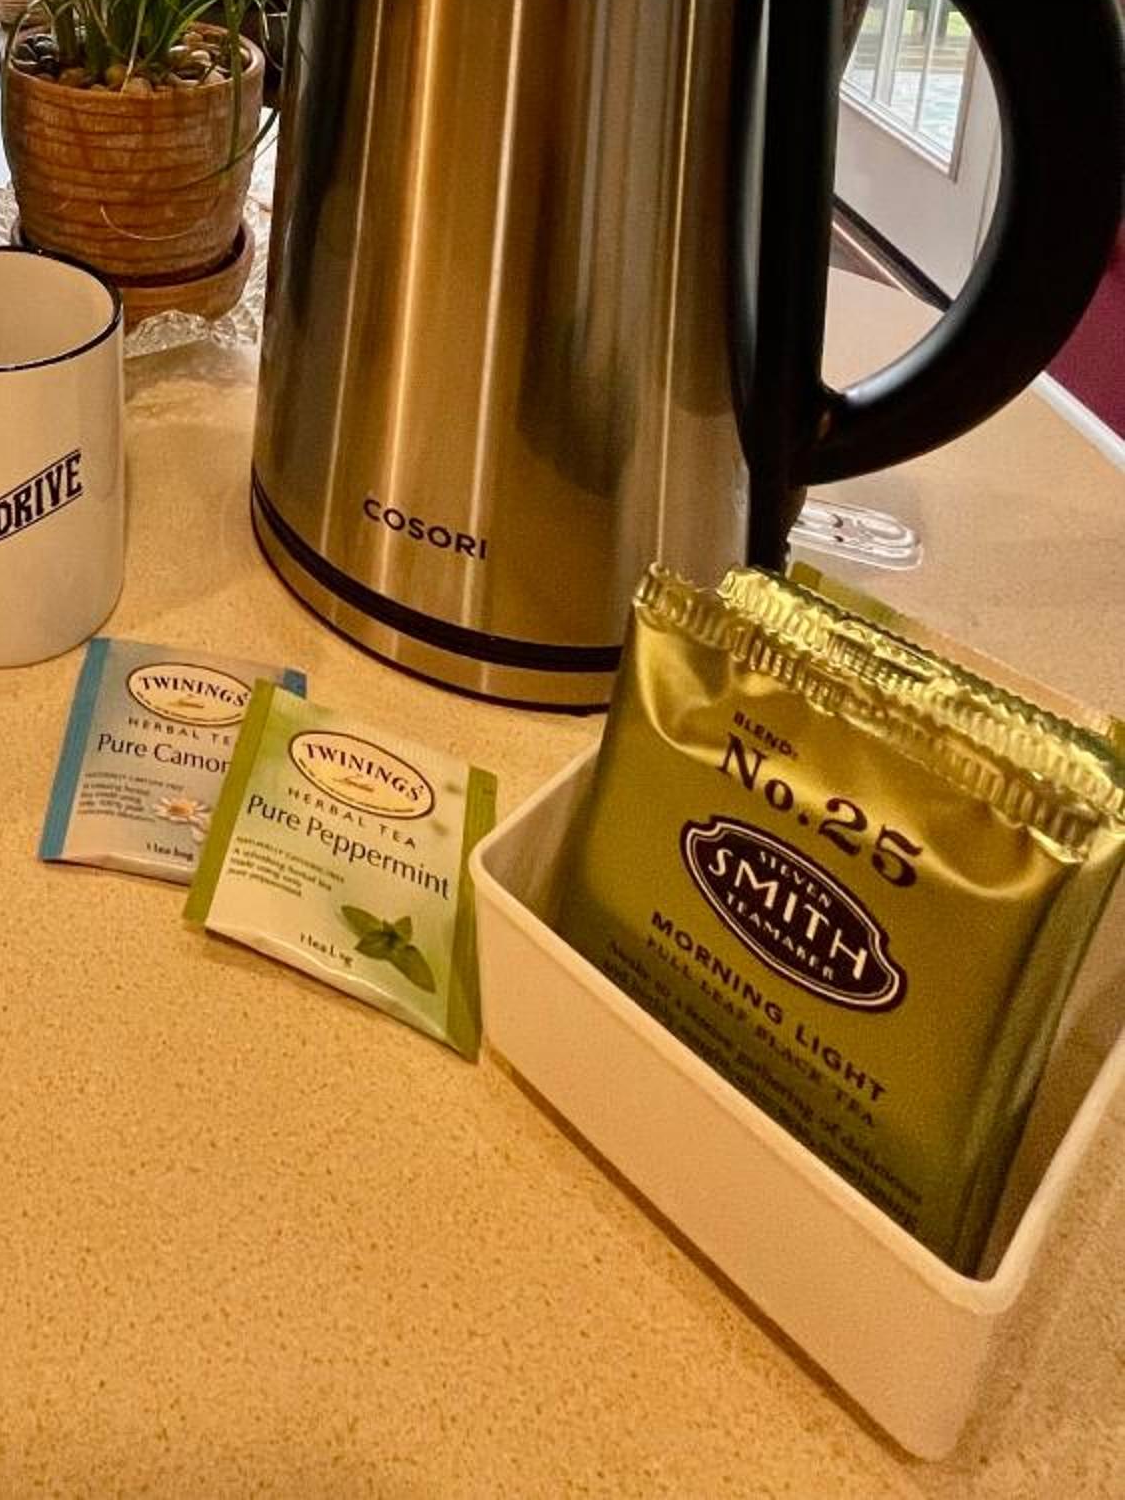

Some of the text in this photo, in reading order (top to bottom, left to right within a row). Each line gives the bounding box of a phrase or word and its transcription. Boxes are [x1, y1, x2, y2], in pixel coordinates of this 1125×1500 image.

[363, 499, 488, 560] COSORI
[139, 675, 248, 708] TWININGS
[97, 733, 148, 758] Pure
[128, 716, 232, 746] HERBAL TE
[303, 742, 424, 802] TWININGS
[246, 793, 450, 901] Pure Peppermint
[287, 787, 417, 850] HERBAL TEA
[759, 850, 832, 908] STEVEN
[708, 848, 868, 980] SMITH
[725, 890, 834, 981] TEAMAKER
[651, 910, 784, 1025] MORNING
[795, 1023, 887, 1102] LIGHT
